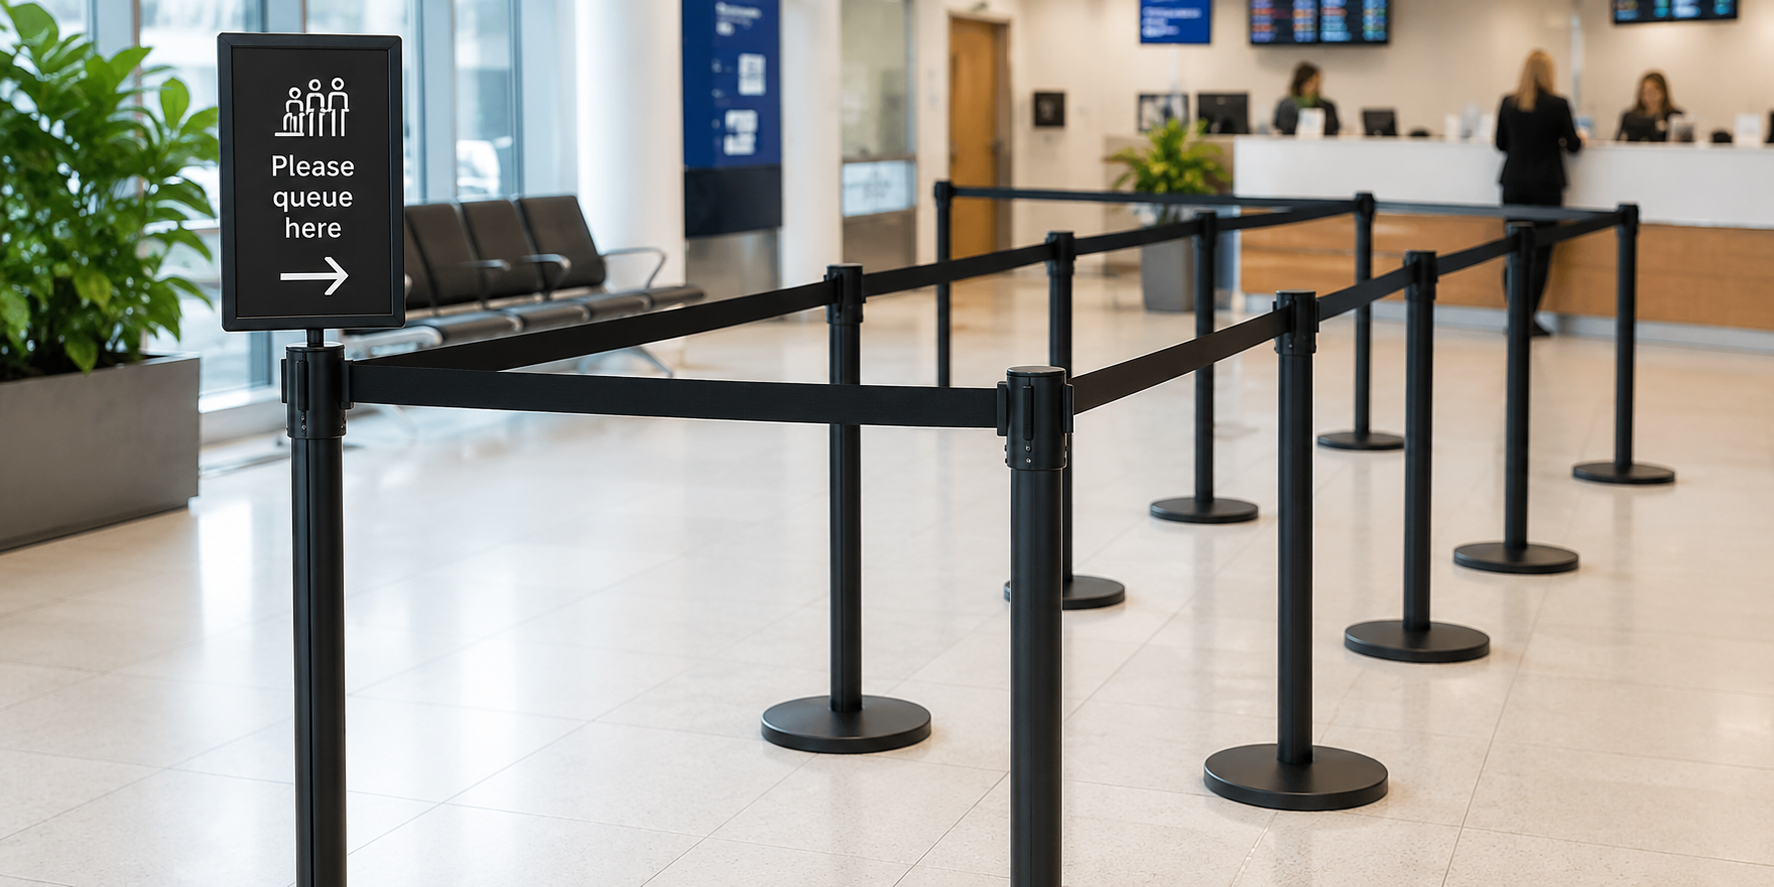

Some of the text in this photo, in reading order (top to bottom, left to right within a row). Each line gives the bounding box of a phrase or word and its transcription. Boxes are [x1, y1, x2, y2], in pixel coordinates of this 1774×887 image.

[272, 154, 355, 177] Please
[273, 190, 353, 213] queue
[285, 216, 342, 239] here
